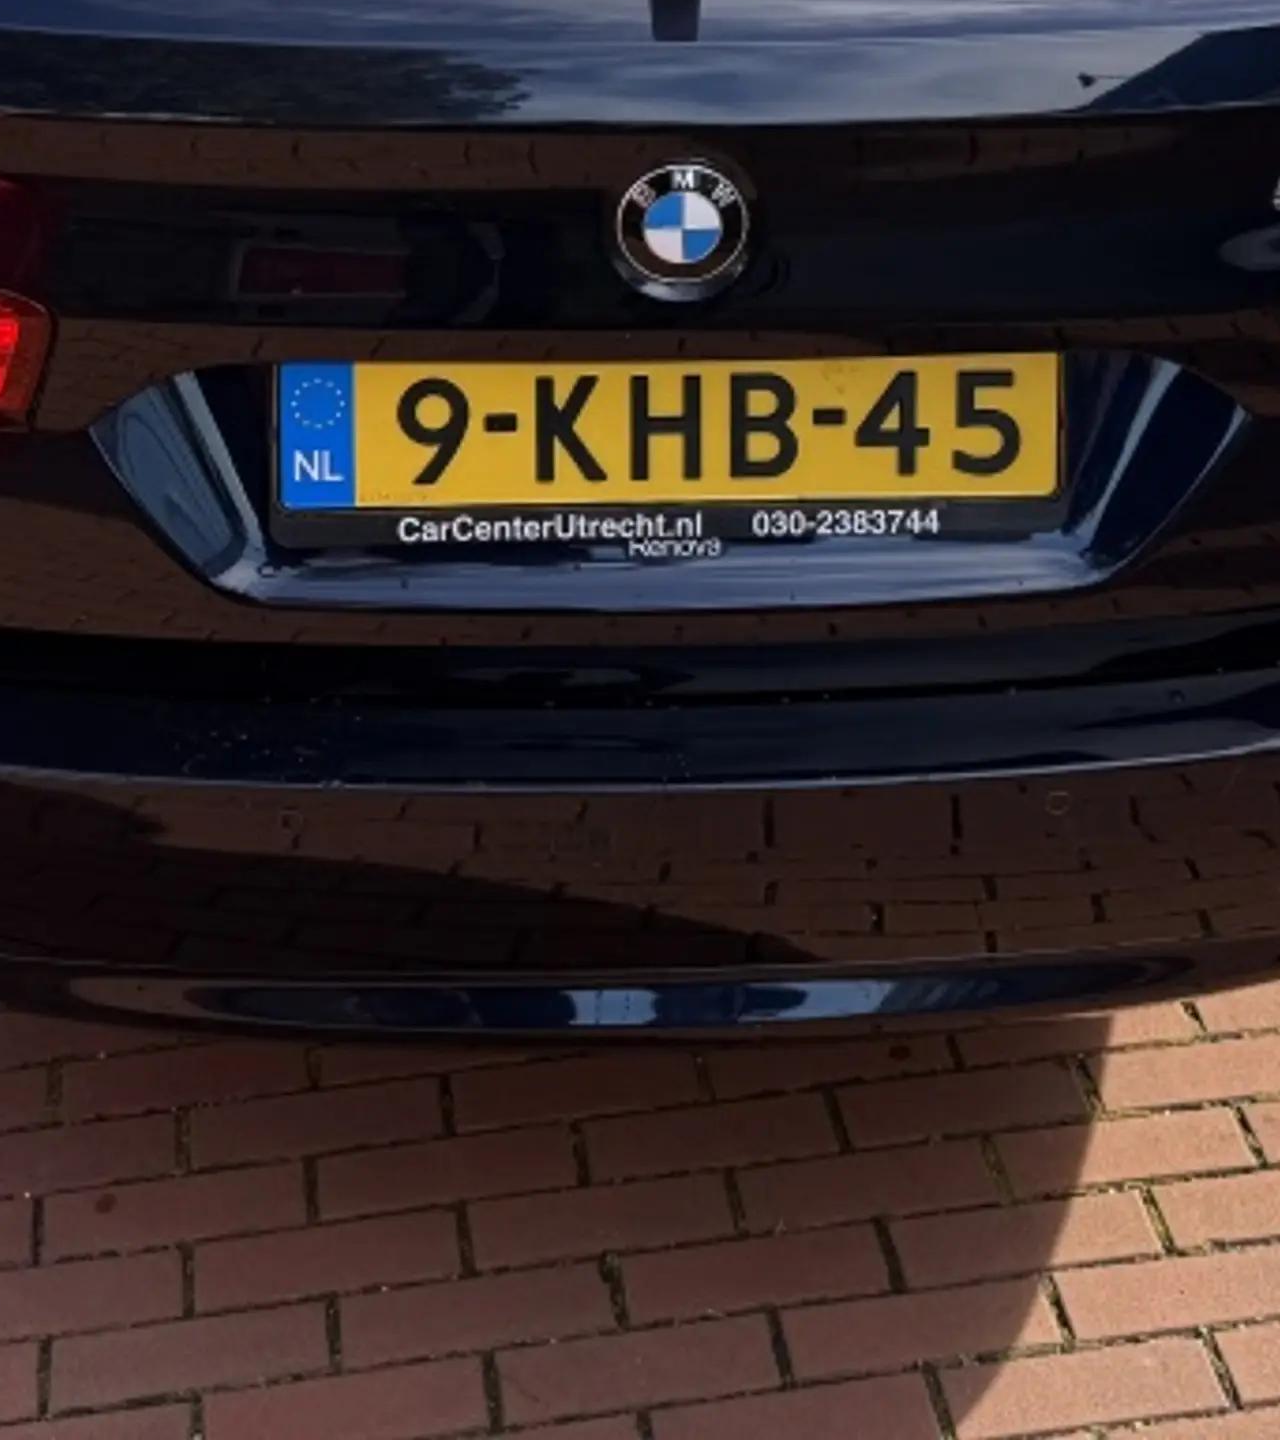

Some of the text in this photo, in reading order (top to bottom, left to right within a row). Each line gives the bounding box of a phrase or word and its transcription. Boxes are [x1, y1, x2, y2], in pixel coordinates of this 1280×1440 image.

[395, 368, 1024, 486] 9-KHB-45
[292, 449, 345, 484] NL
[396, 508, 941, 544] CarCenterUtrecht.nl 030-2383744
